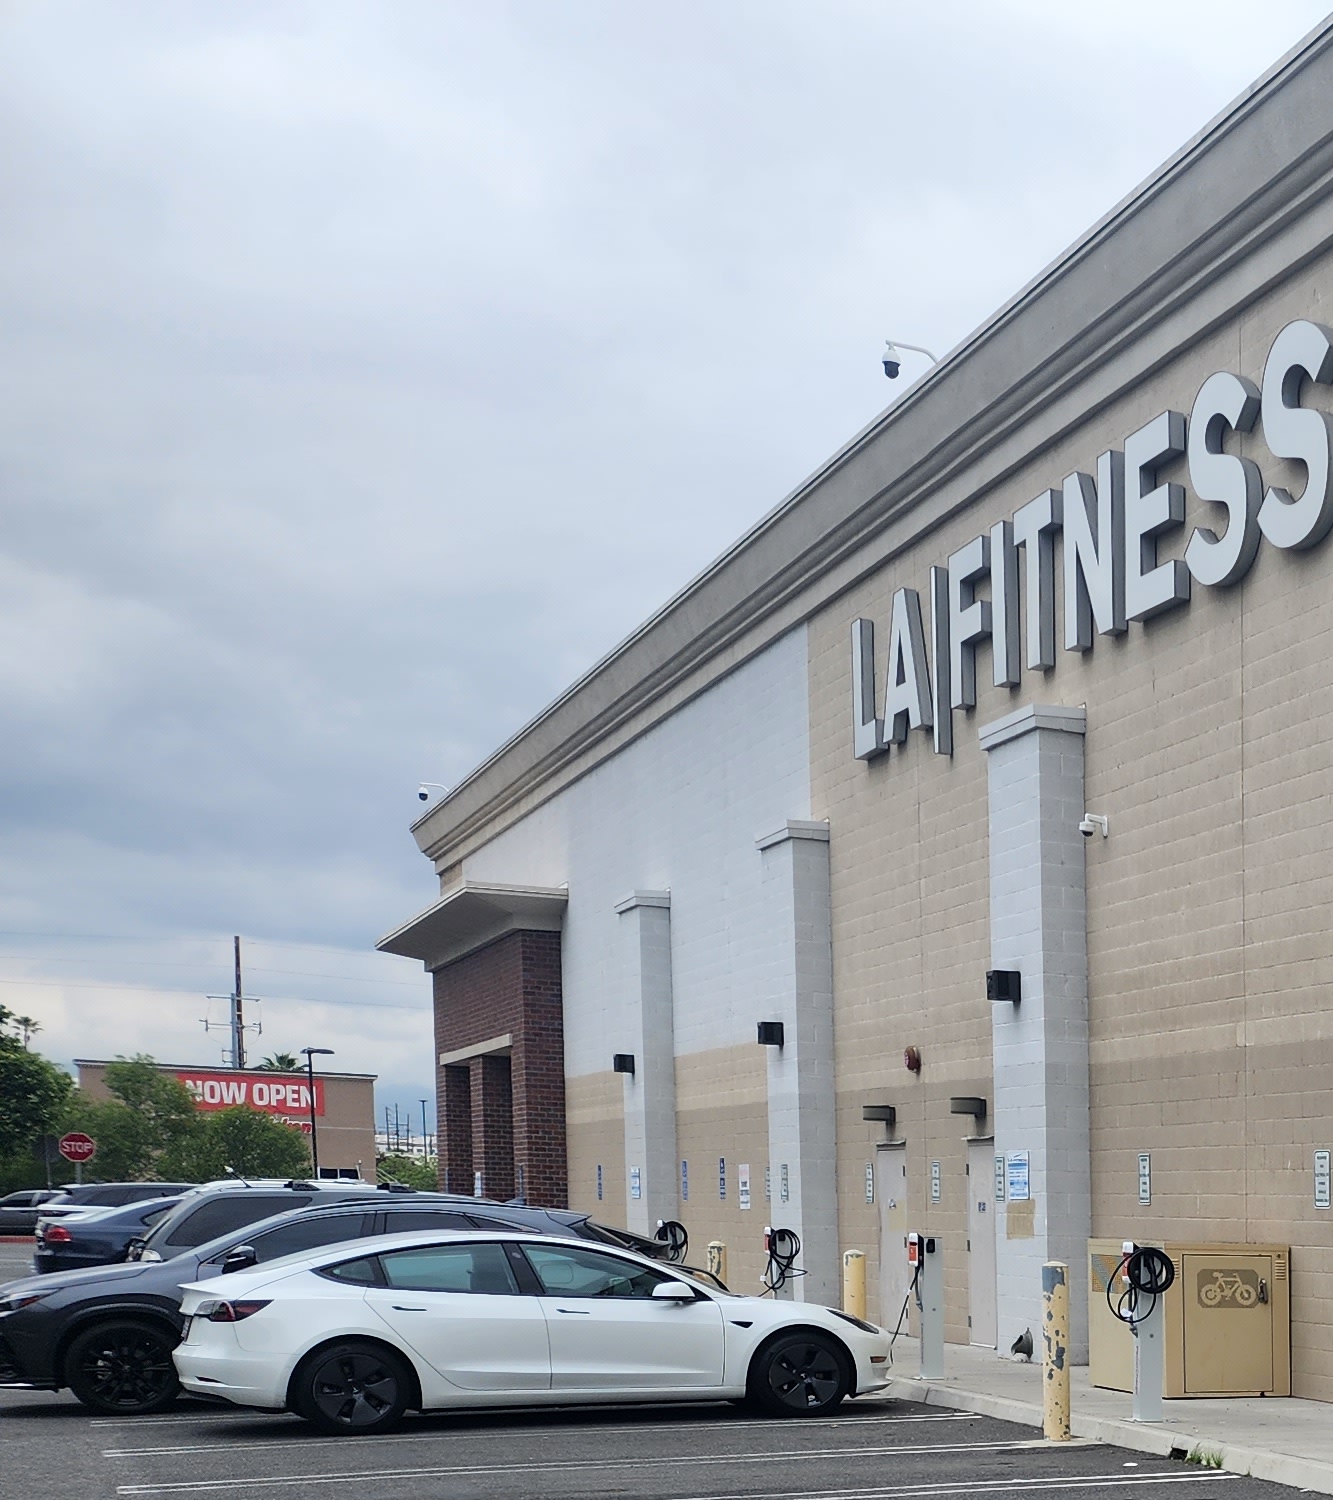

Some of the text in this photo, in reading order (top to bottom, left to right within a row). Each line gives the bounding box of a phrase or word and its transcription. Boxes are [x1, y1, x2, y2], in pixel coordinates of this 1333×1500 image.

[850, 586, 933, 761] LA
[185, 1079, 317, 1109] NOW OPEN
[61, 1140, 93, 1153] STOP
